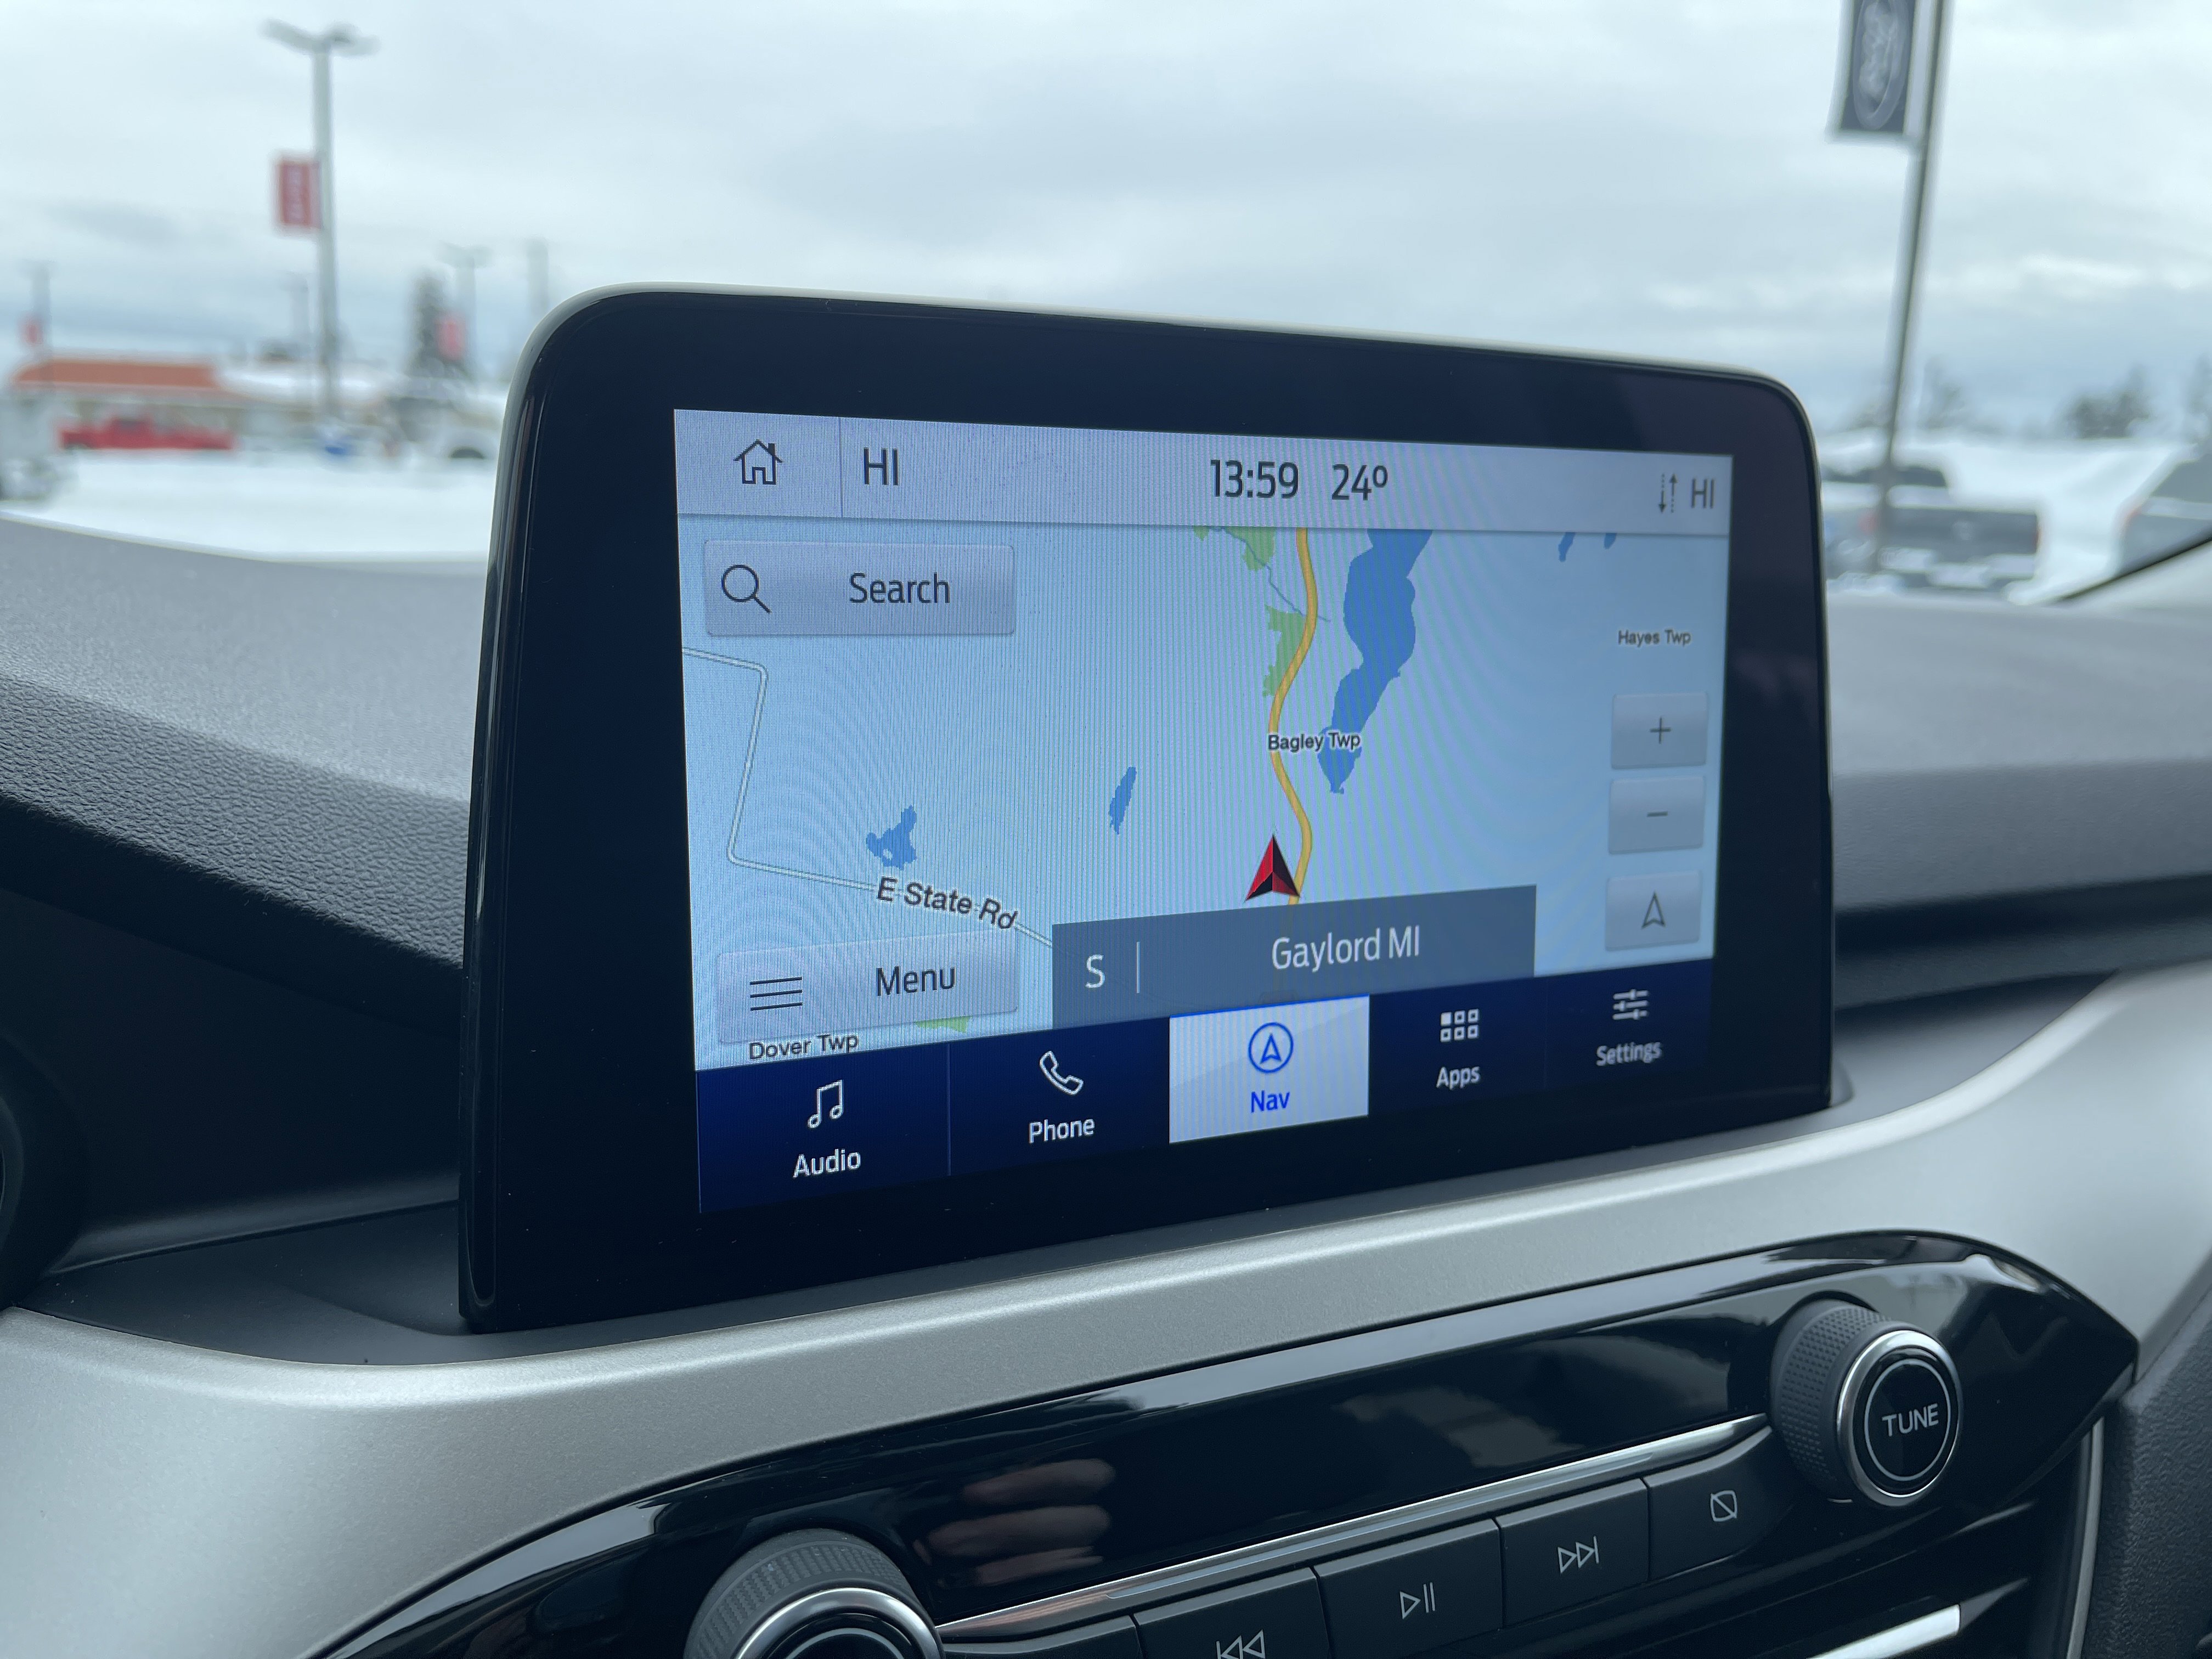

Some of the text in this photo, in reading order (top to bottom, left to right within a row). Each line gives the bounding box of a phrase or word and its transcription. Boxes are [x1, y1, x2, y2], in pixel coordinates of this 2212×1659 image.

[863, 447, 899, 486] HI
[1210, 459, 1299, 500] 13:59
[1691, 477, 1715, 510] HI
[849, 572, 951, 605] Search
[1618, 630, 1691, 648] Hayes Twp
[1268, 732, 1361, 753] Bagley Twp
[877, 877, 1018, 930] E State Rd
[1272, 926, 1420, 973] Gaylord MI
[877, 965, 956, 997] Menu
[1086, 954, 1105, 989] S
[749, 1032, 859, 1060] Dover Twp
[1596, 1040, 1662, 1066] Settings
[1436, 1064, 1481, 1090] Apps
[1250, 1091, 1290, 1113] Nav
[1029, 1116, 1095, 1144] Phone
[793, 1148, 861, 1178] Audio
[1882, 1403, 1939, 1437] TUNE
